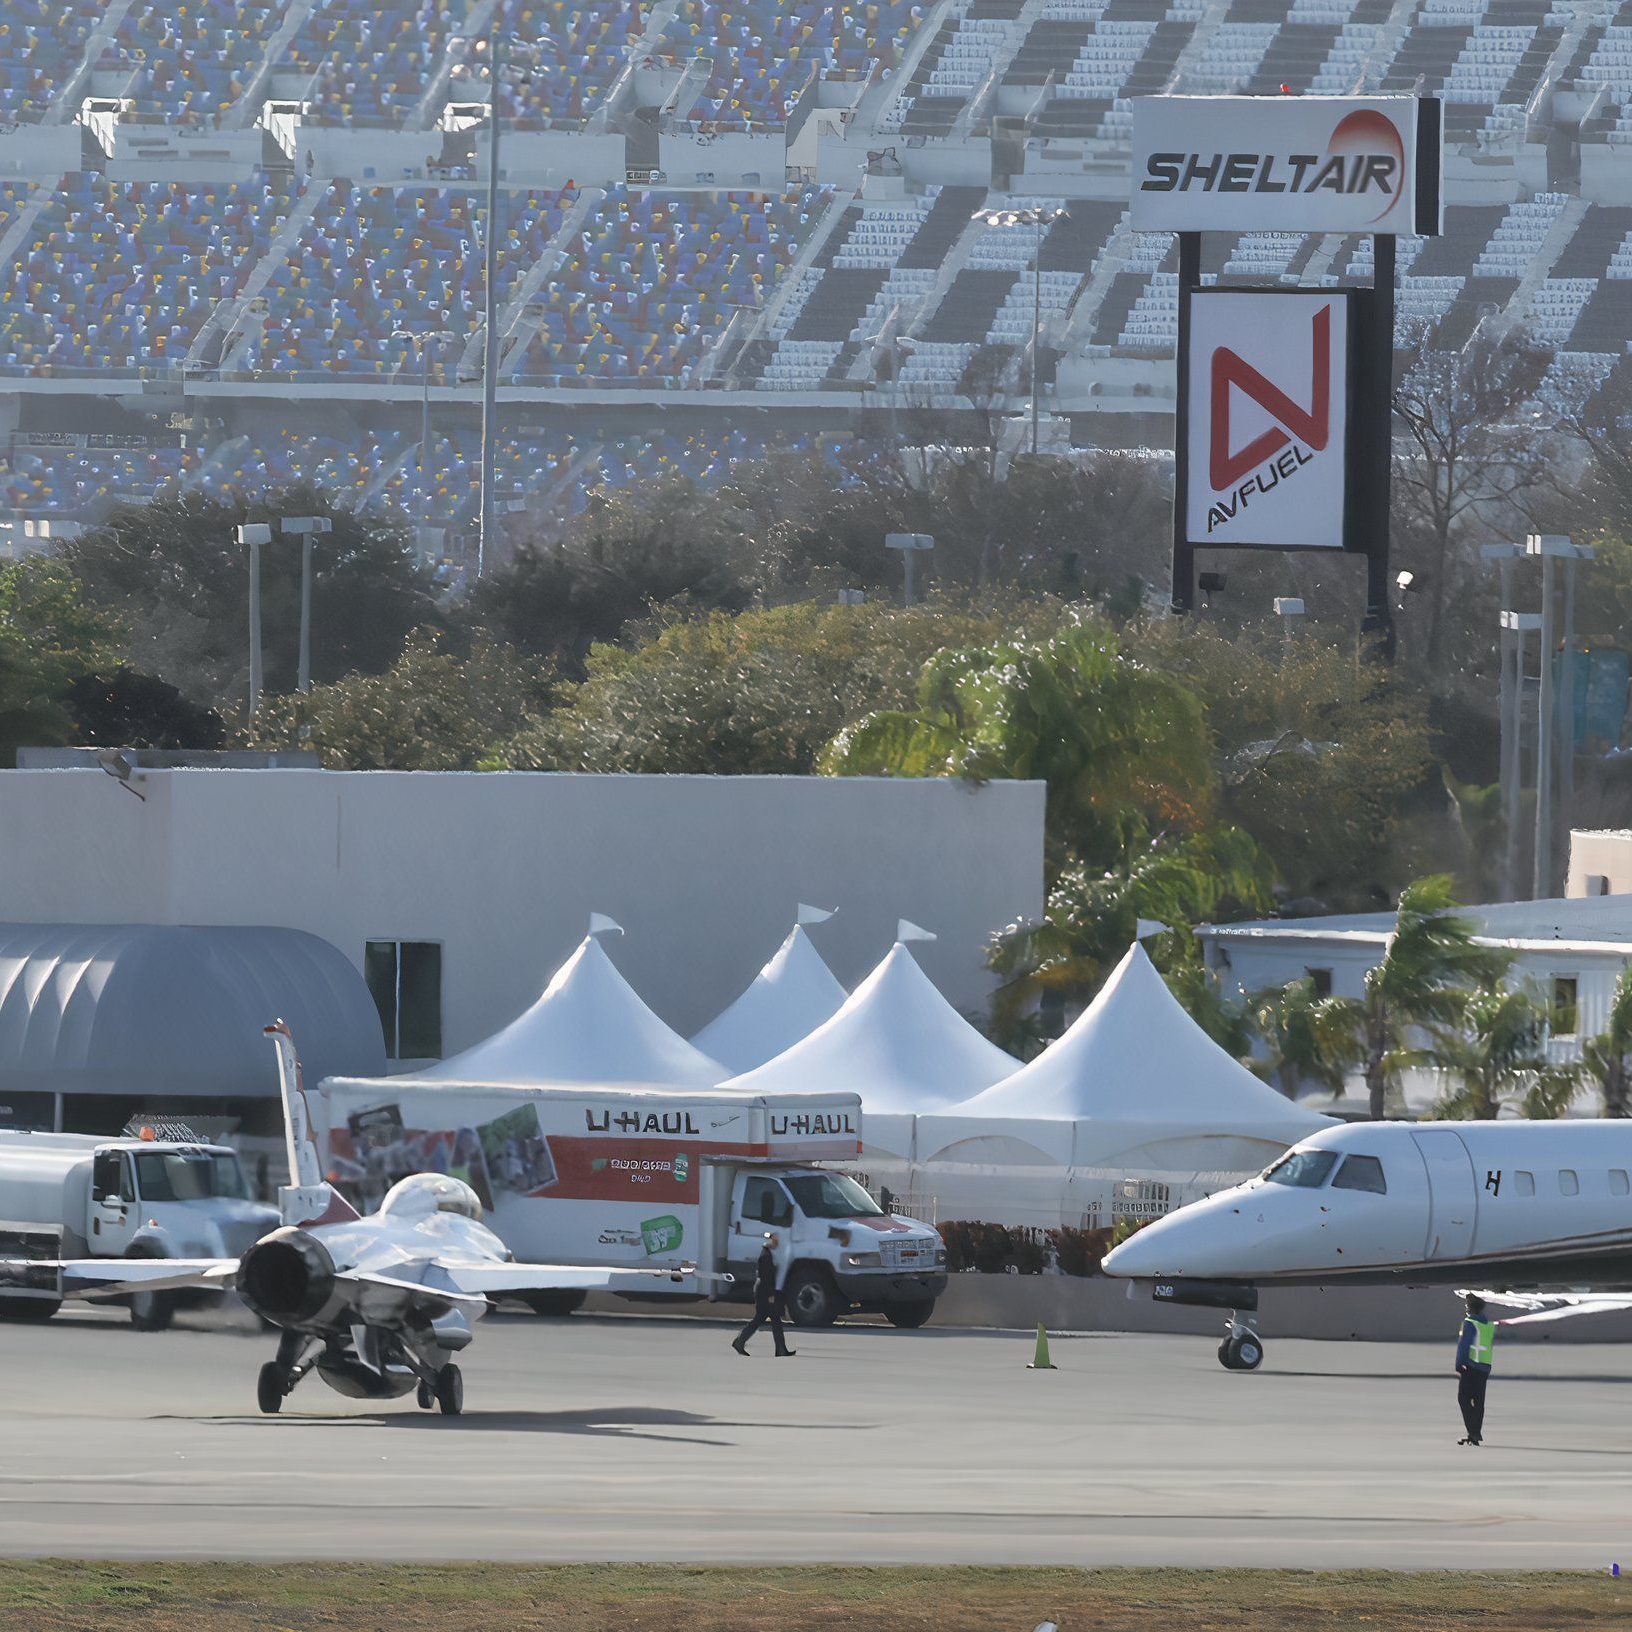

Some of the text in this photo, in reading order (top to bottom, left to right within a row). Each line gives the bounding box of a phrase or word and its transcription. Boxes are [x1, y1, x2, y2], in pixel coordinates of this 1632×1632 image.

[1141, 152, 1398, 194] SHELTAIR
[1207, 445, 1314, 532] AVFUEL
[585, 1109, 700, 1135] U-HAUL
[771, 1114, 855, 1135] U-HAUL
